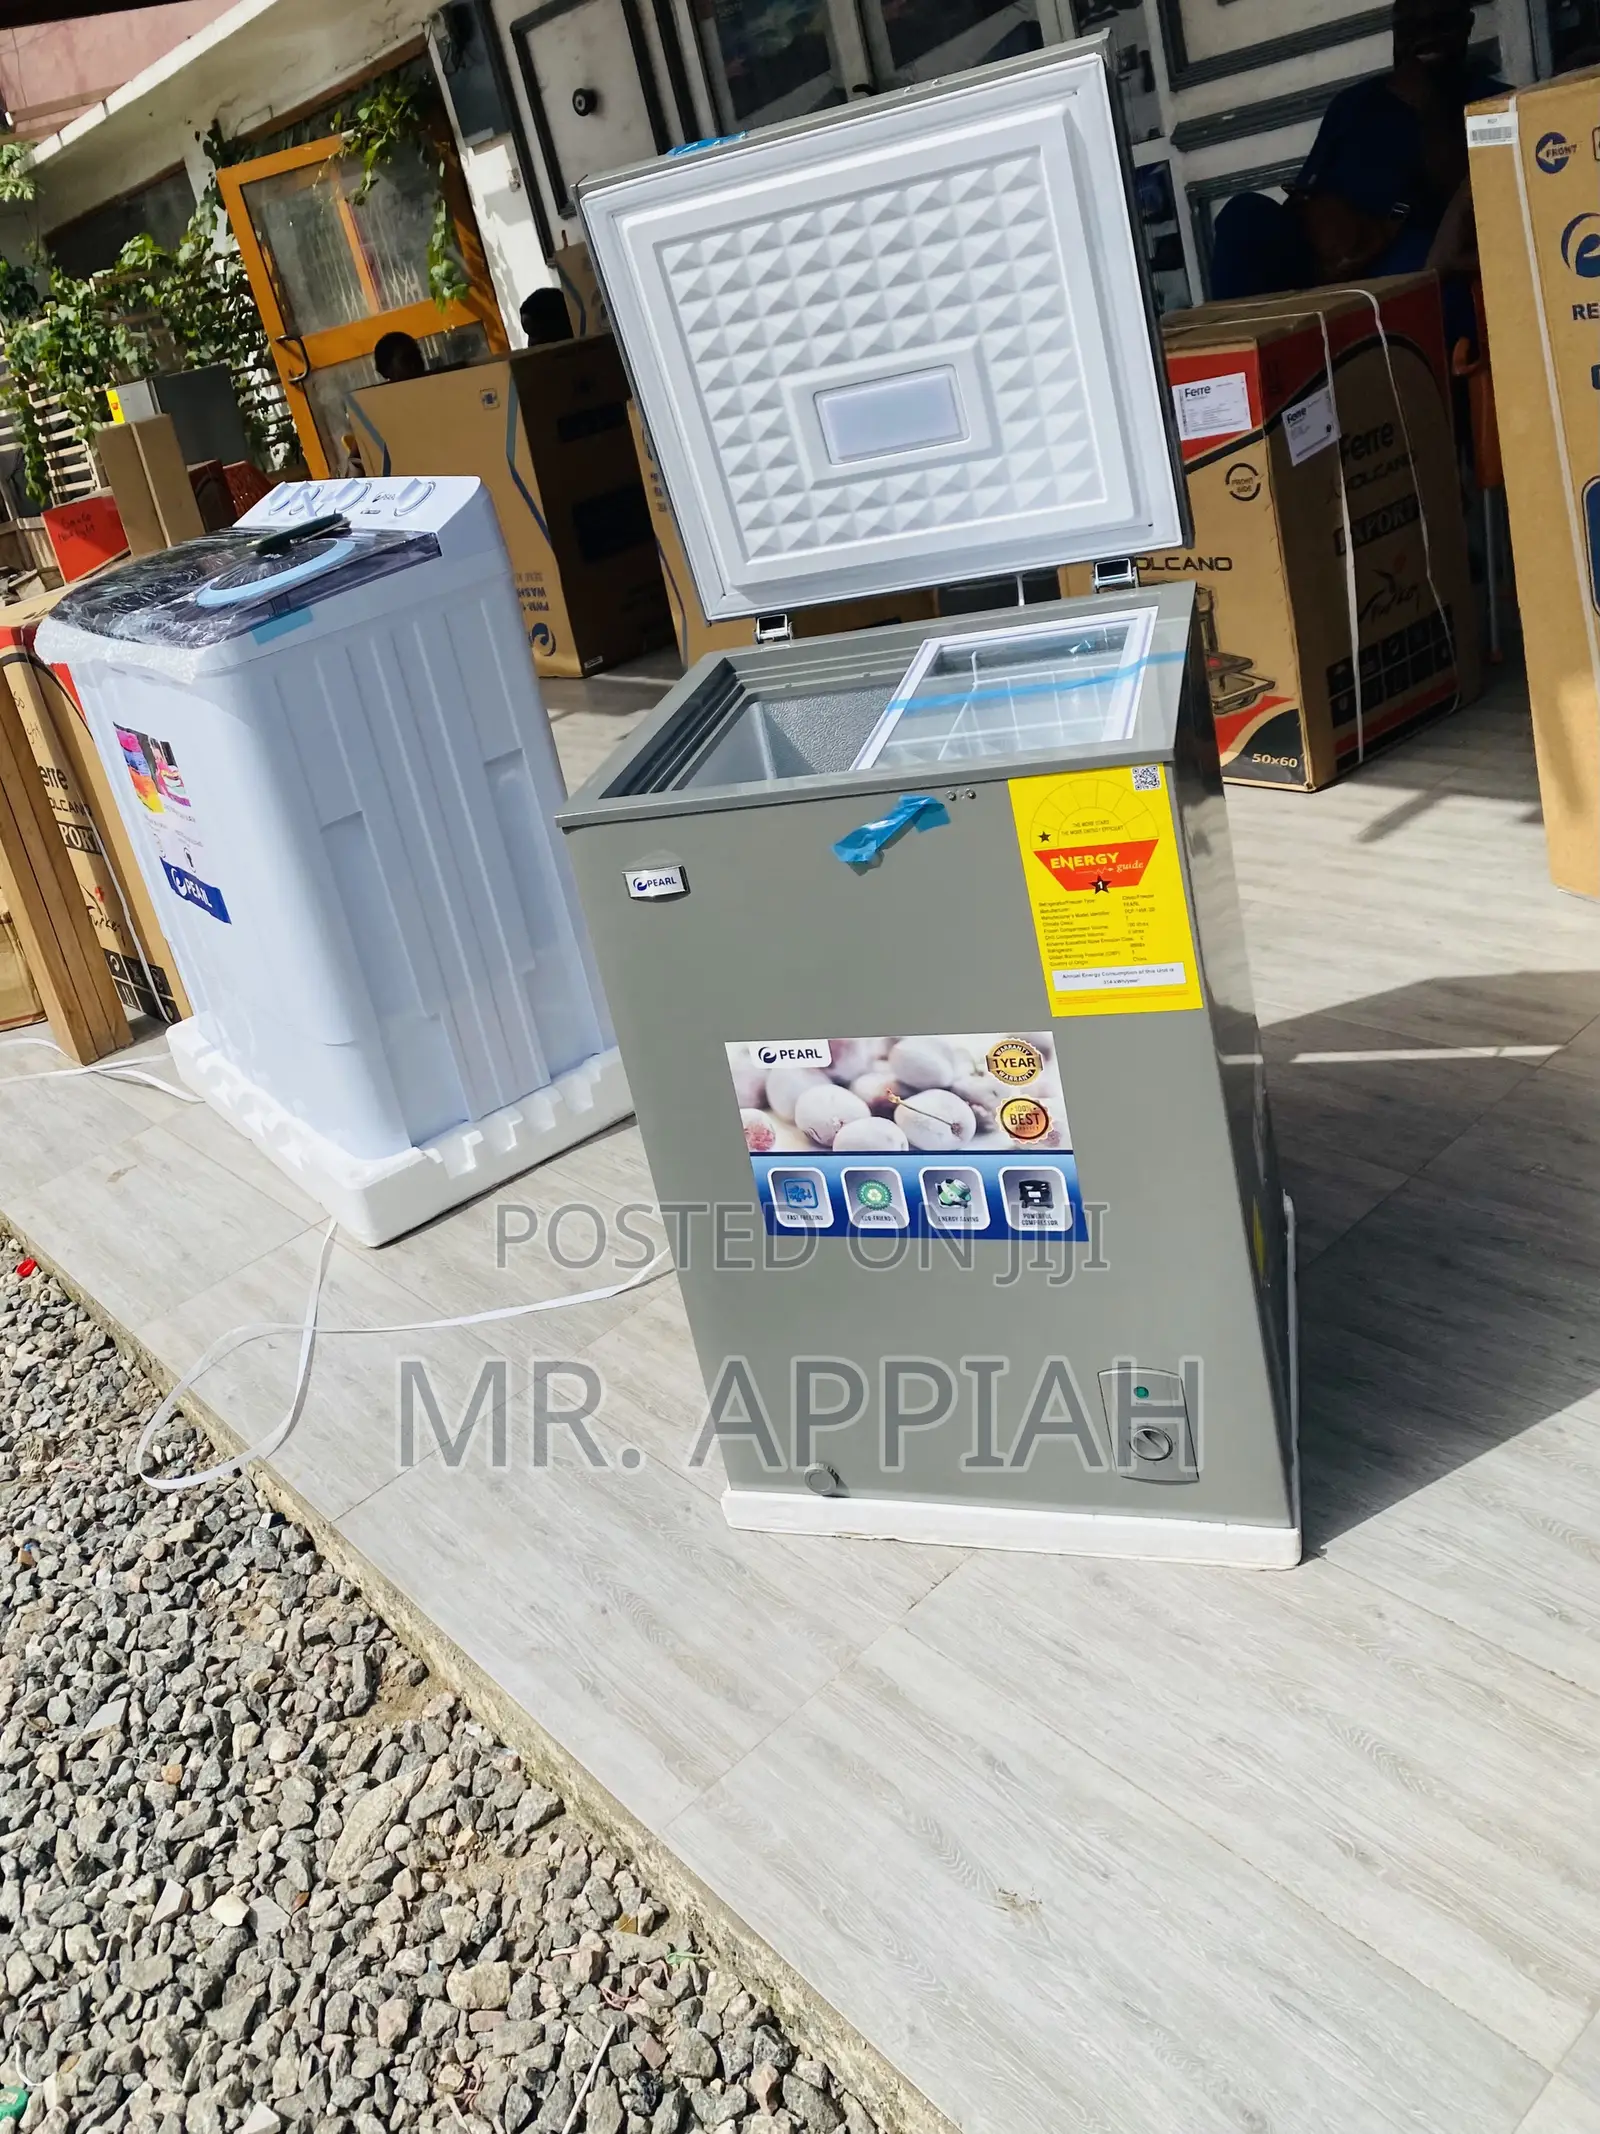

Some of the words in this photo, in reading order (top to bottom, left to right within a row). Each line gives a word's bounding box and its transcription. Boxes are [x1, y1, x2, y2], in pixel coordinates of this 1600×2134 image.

[1546, 144, 1577, 158] FRONT
[1185, 384, 1212, 398] Ferre
[1287, 407, 1307, 424] Ferre
[1135, 556, 1233, 571] OLCANO
[1251, 753, 1298, 768] 50x60
[38, 765, 69, 790] erre
[1050, 852, 1119, 871] ENERGY
[1116, 860, 1144, 874] guide
[647, 877, 677, 888] PEARL
[1098, 880, 1104, 890] 1
[780, 1049, 822, 1060] PEARL
[996, 1043, 1031, 1056] WARRANTY
[992, 1059, 999, 1068] 1
[1000, 1058, 1036, 1068] YEAR
[999, 1069, 1034, 1082] WARRANTY
[1009, 1113, 1040, 1126] BEST
